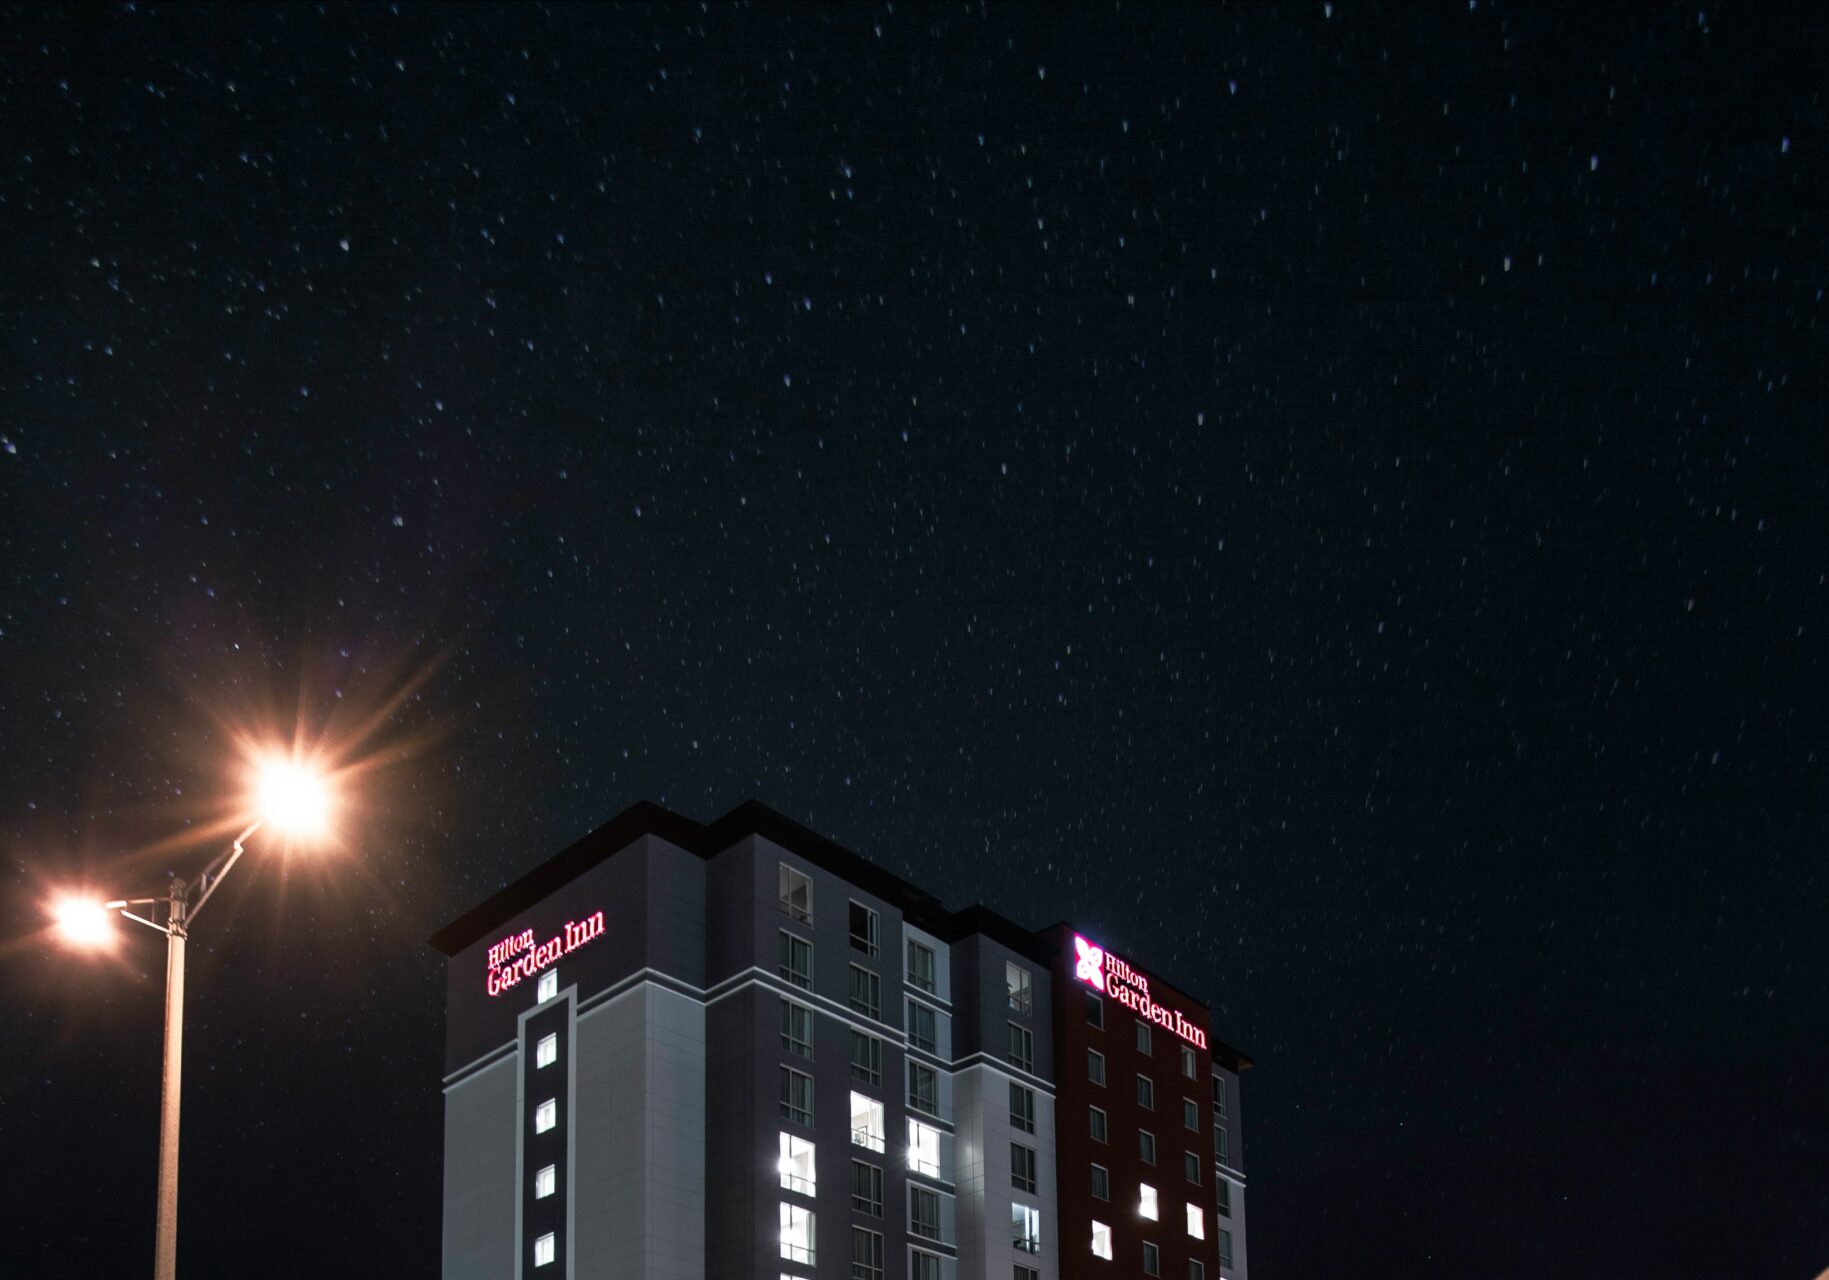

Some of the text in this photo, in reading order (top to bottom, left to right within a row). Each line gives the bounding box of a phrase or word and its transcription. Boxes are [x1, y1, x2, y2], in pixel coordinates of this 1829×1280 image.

[487, 911, 605, 997] Garden Inn
[488, 928, 535, 970] Hilton
[1104, 951, 1149, 993] Hilton
[1105, 972, 1207, 1049] Garden Inn
